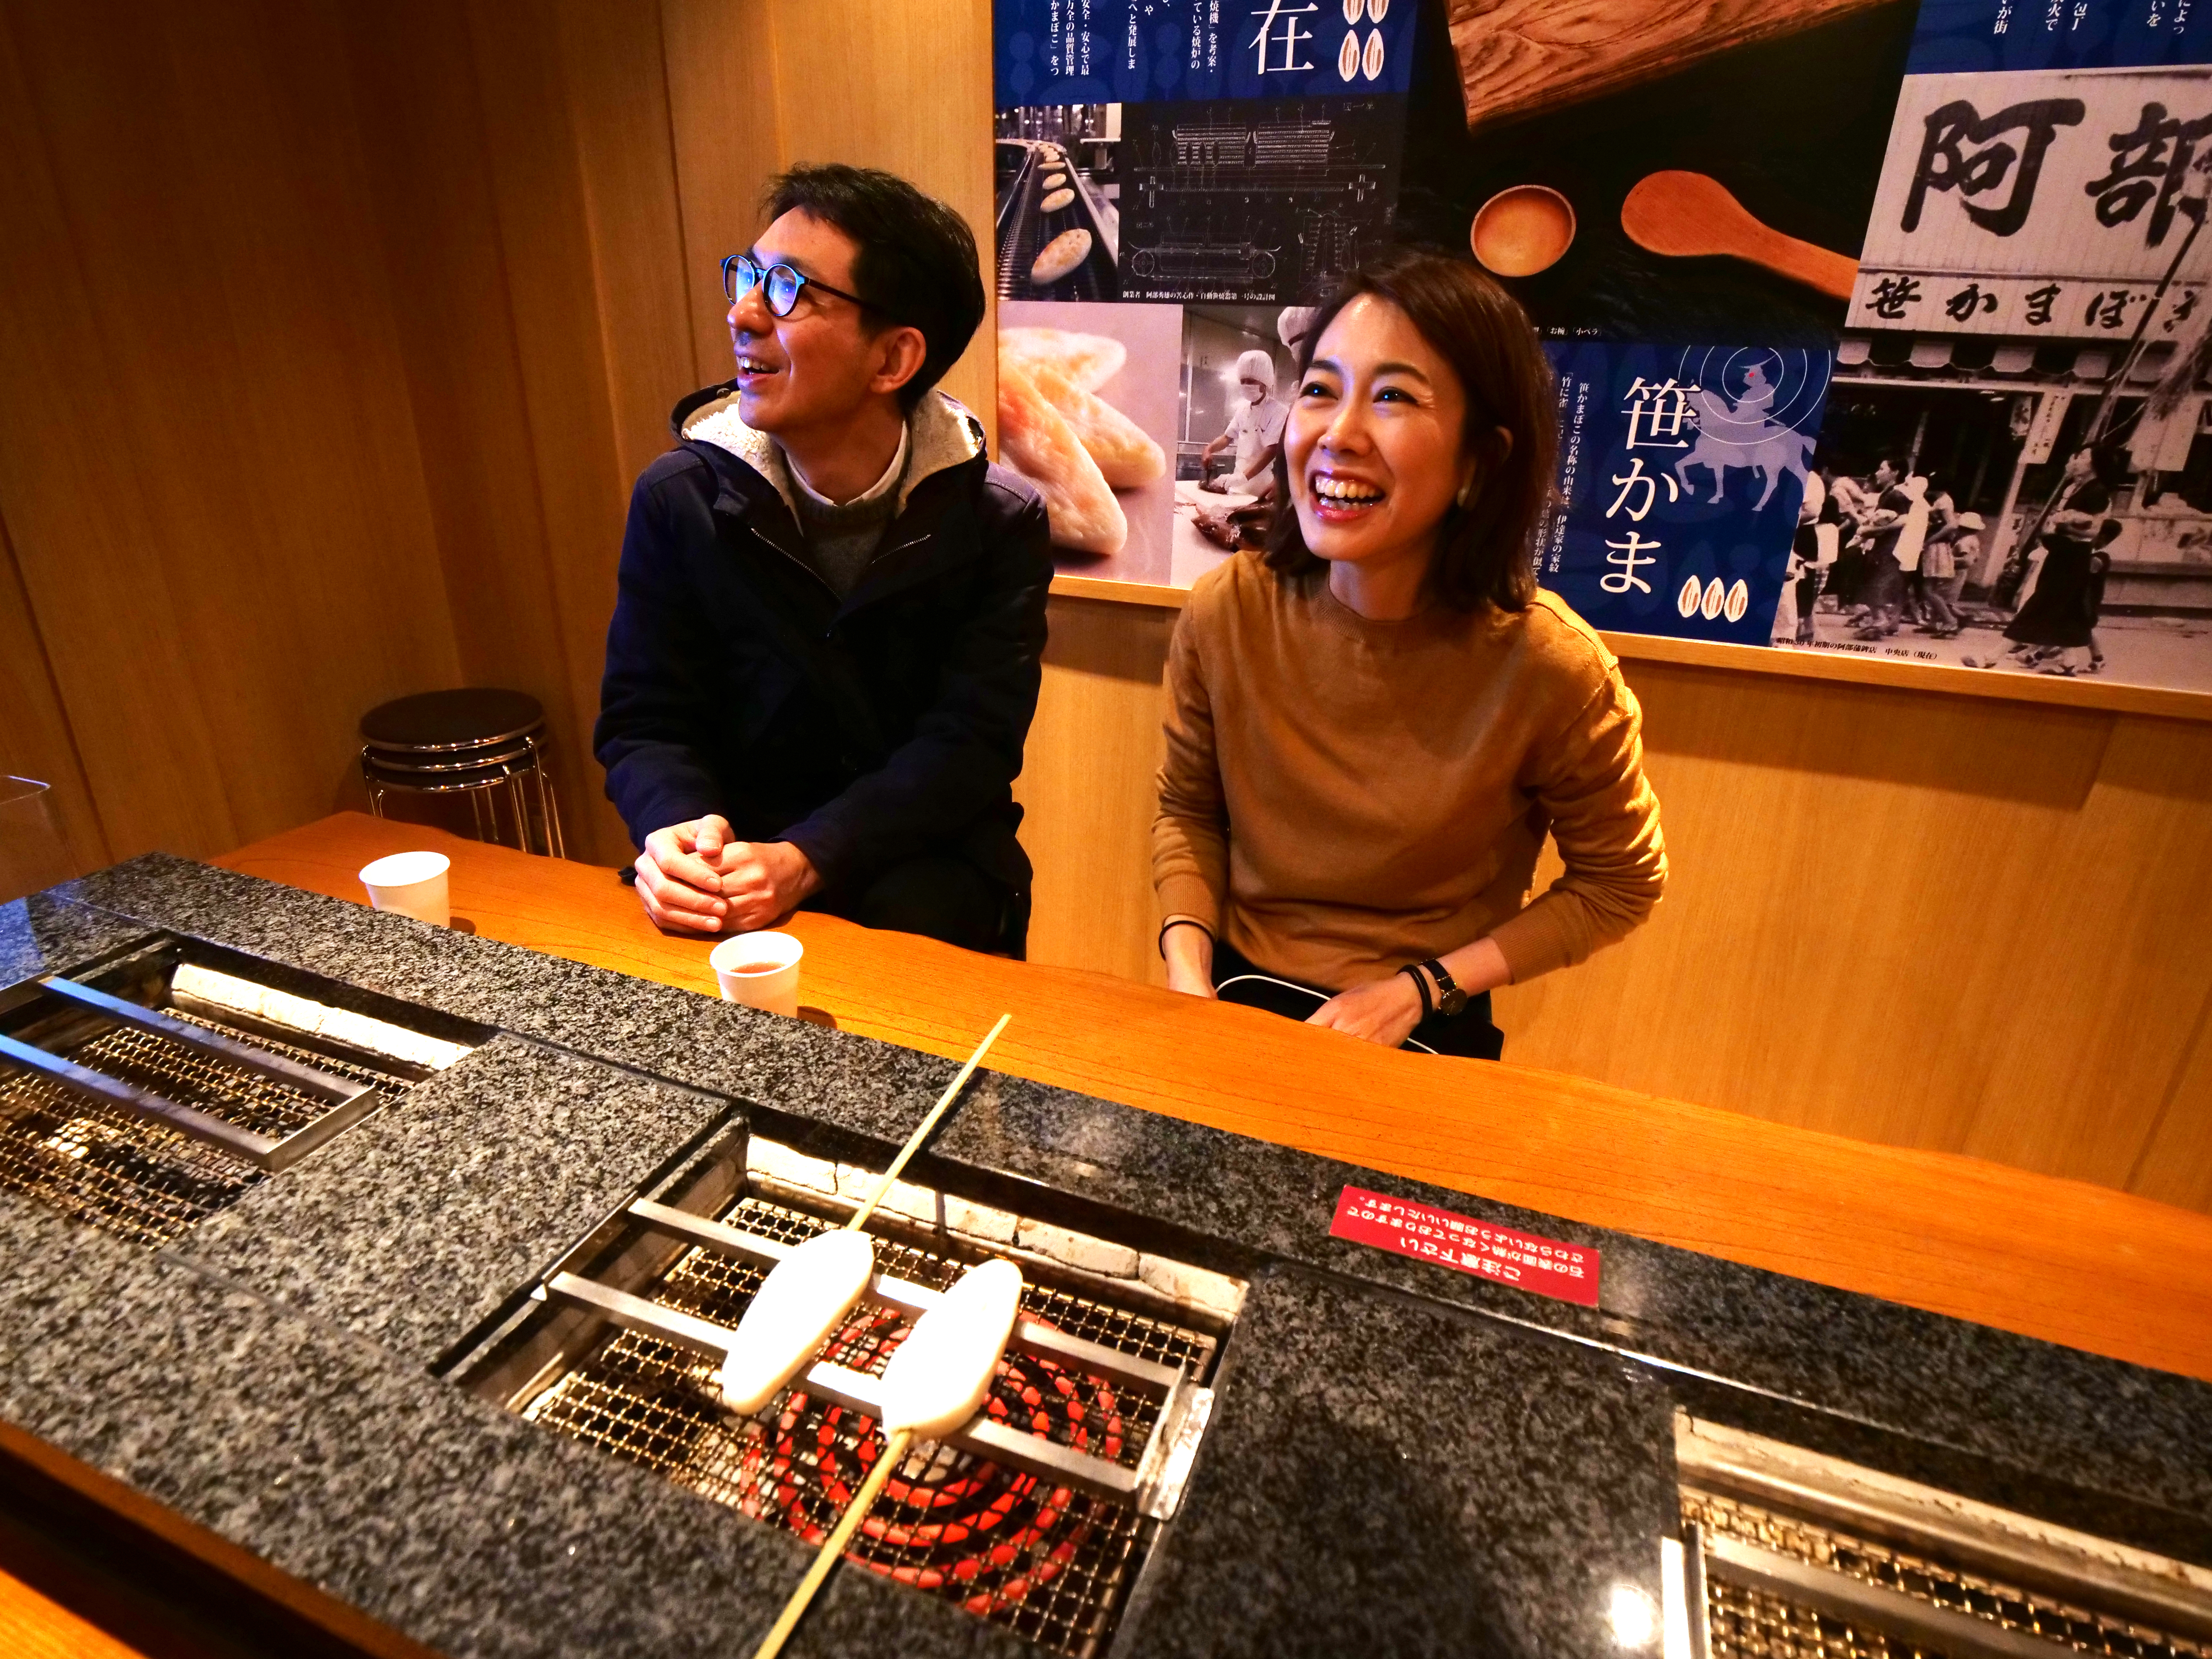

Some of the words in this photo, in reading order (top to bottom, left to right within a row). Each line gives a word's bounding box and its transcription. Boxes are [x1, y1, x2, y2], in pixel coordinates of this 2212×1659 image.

[1249, 0, 1318, 75] 在
[1994, 0, 2013, 34] が街
[2046, 0, 2064, 31] 火で
[1599, 376, 1703, 594] 笹かま
[1400, 1237, 1521, 1281] ご注意下さい
